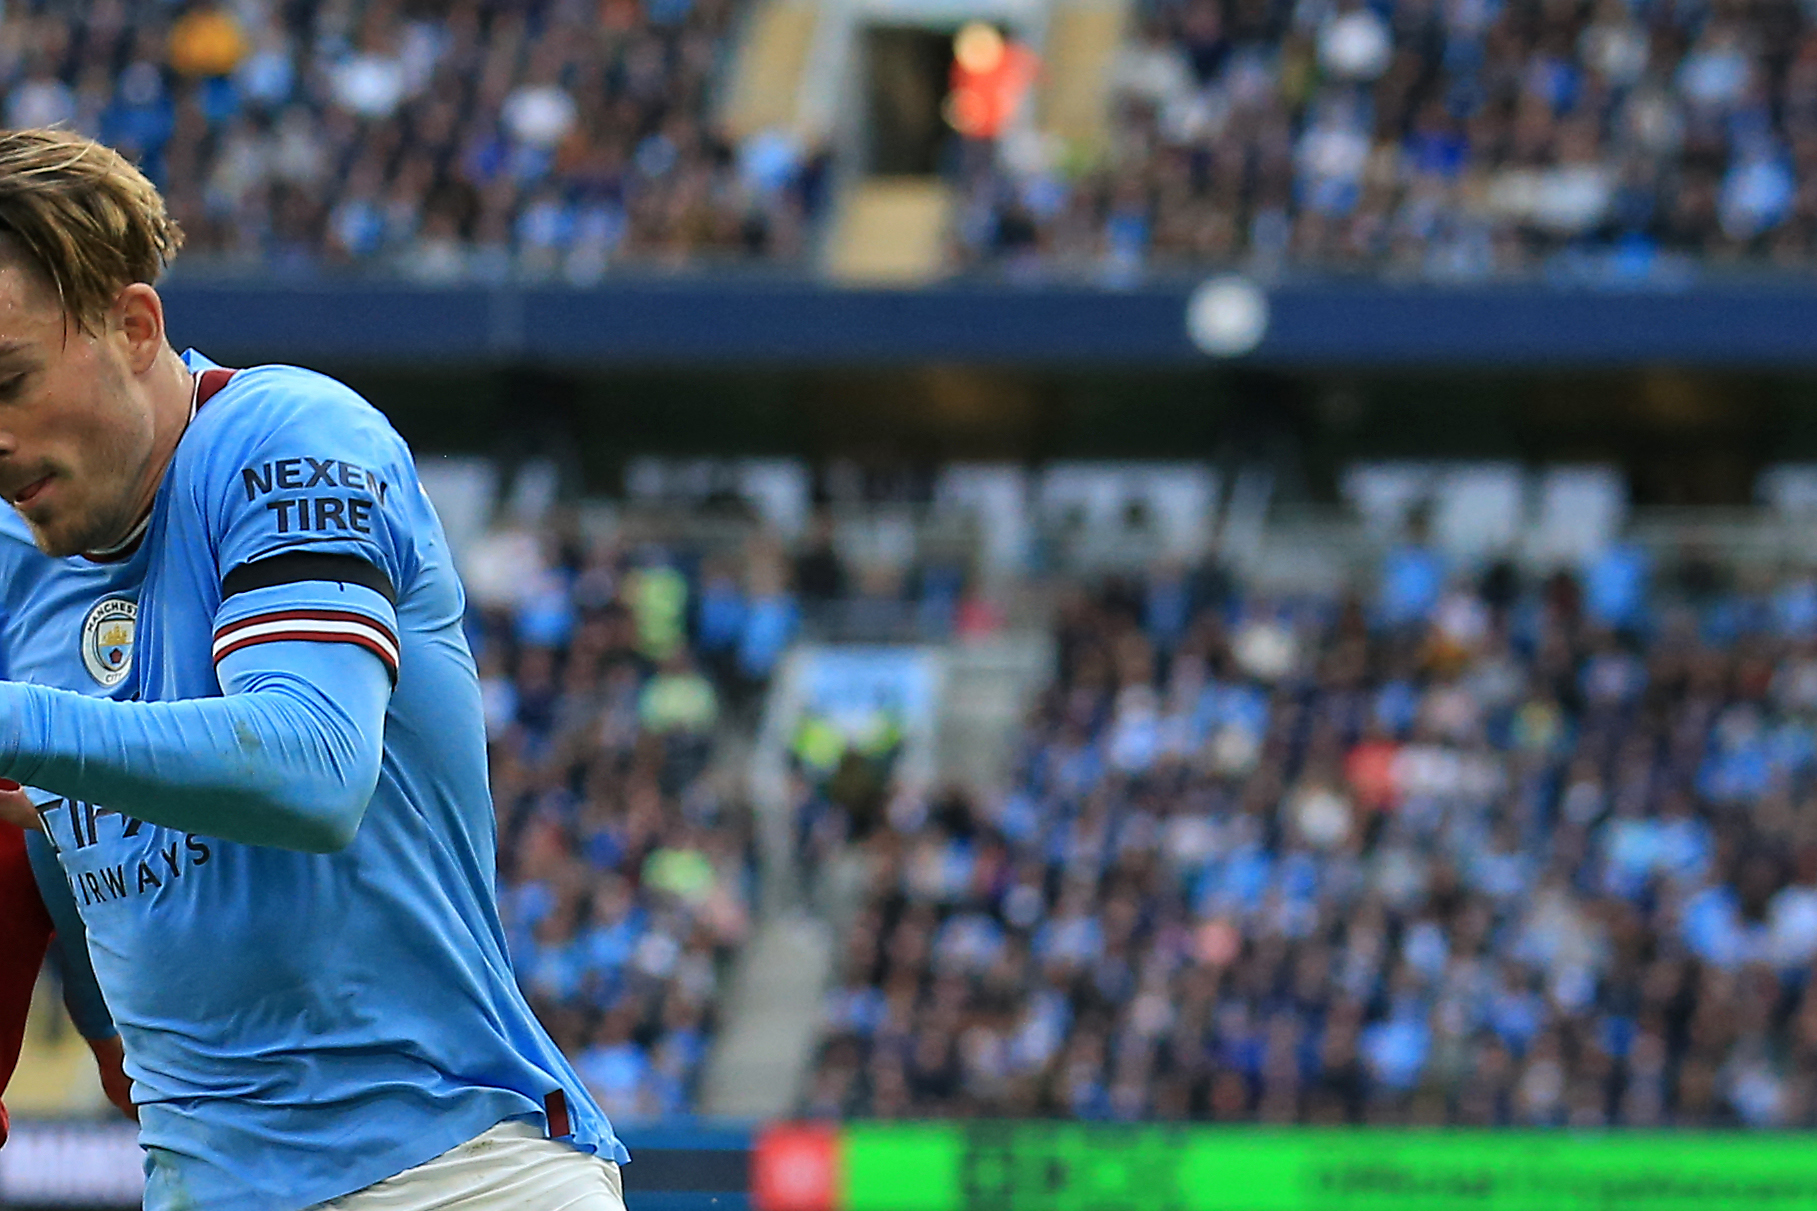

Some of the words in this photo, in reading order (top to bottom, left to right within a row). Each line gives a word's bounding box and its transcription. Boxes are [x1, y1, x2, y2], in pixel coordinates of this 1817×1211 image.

[267, 498, 373, 534] TIRE
[87, 602, 138, 632] MANCHEST
[69, 833, 211, 906] IRWAYS
